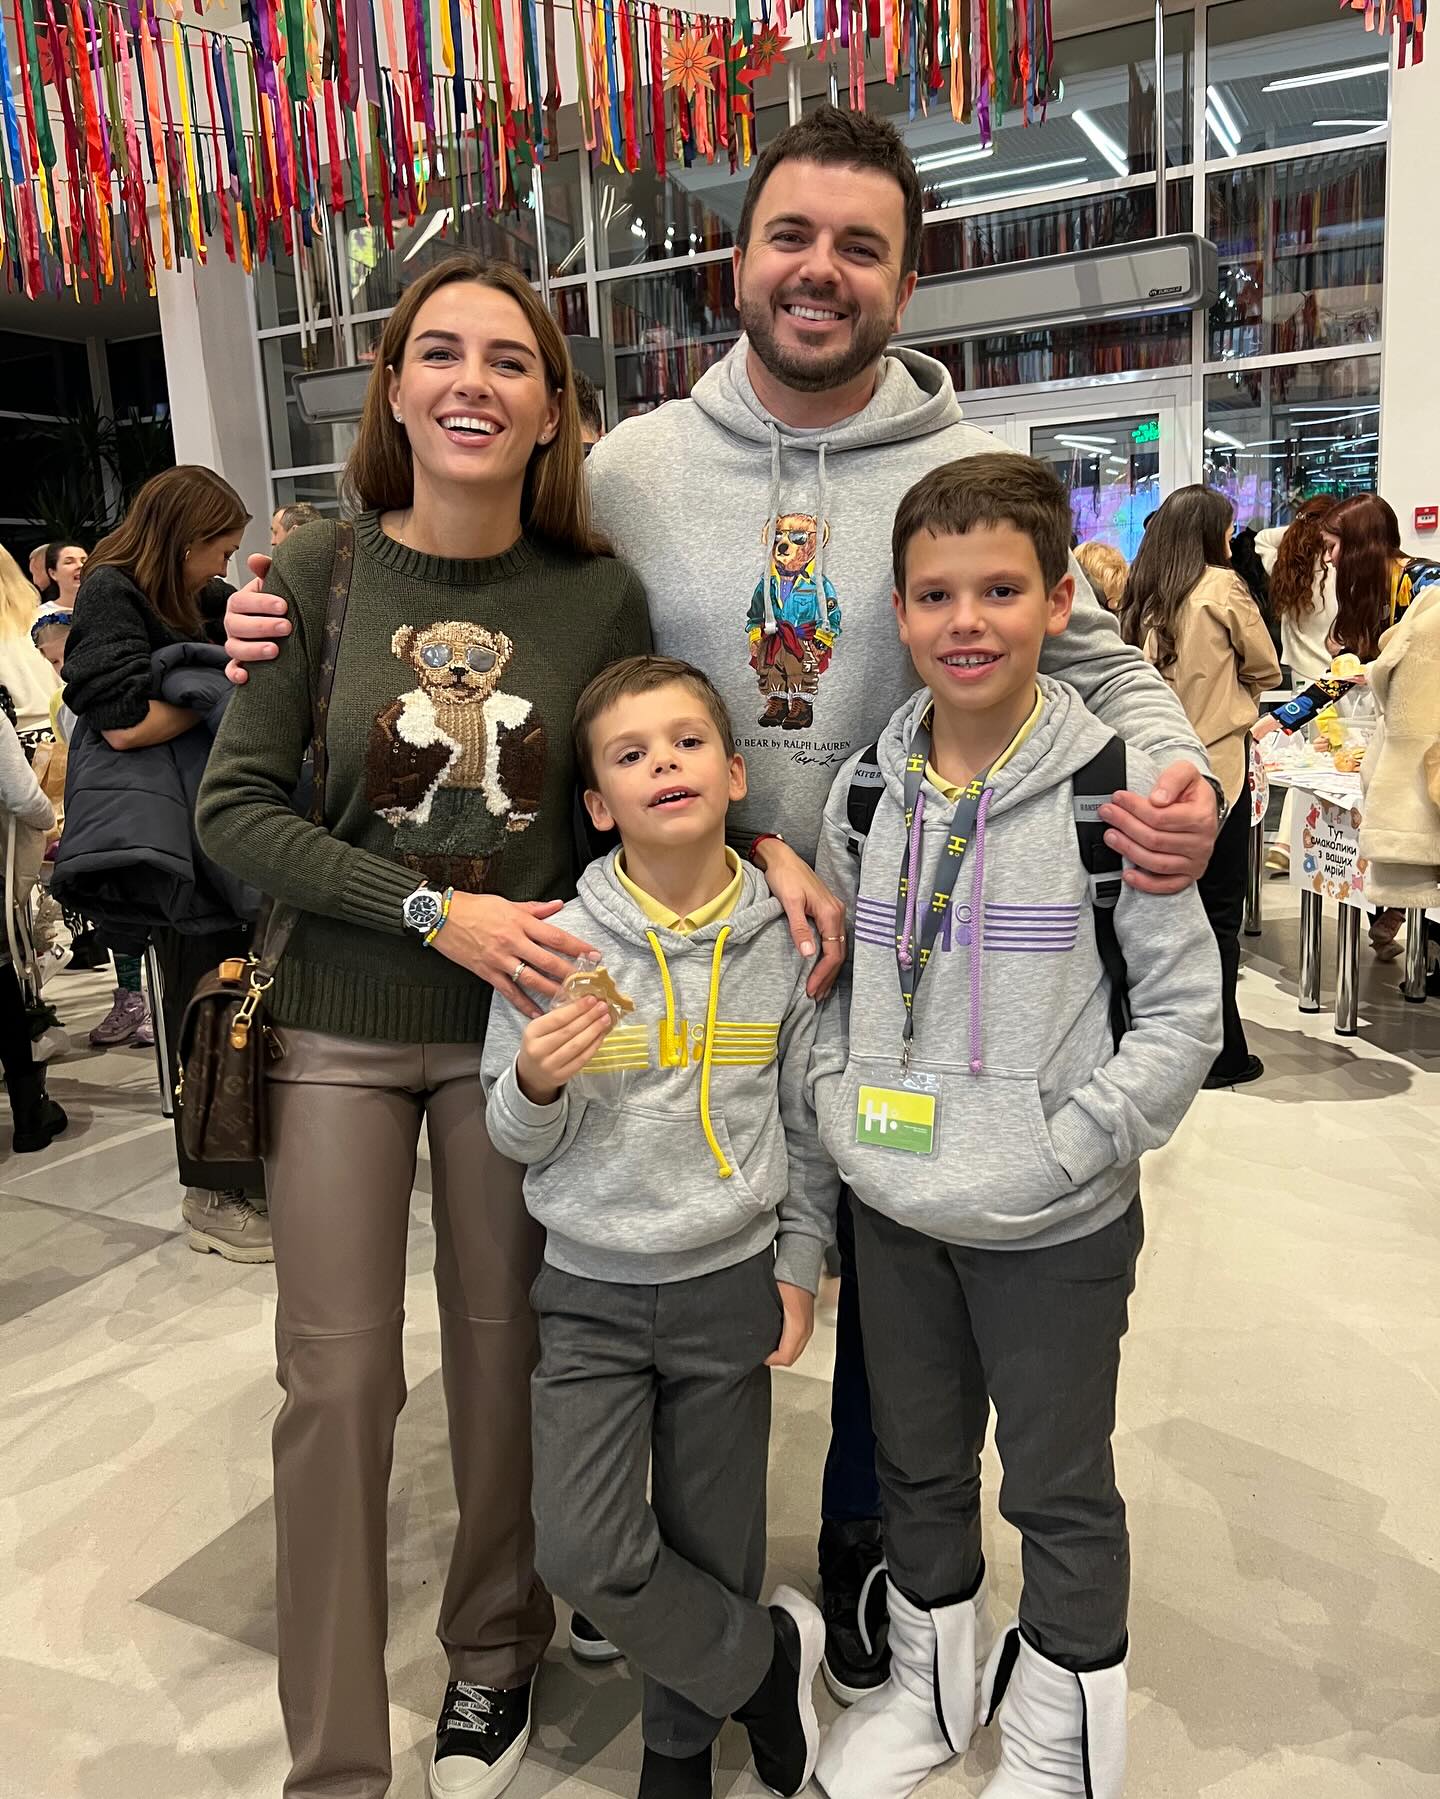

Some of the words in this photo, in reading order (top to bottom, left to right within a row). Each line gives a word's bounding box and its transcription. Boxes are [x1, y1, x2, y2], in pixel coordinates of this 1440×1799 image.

[744, 739, 769, 747] BEAR
[771, 739, 781, 749] by
[784, 740, 811, 750] RALPH
[814, 741, 851, 751] LAUREN
[1328, 825, 1344, 841] Тут
[1311, 836, 1356, 856] смаколики
[1318, 850, 1322, 859] з
[1326, 853, 1353, 867] ваших
[1324, 864, 1346, 878] мрій!
